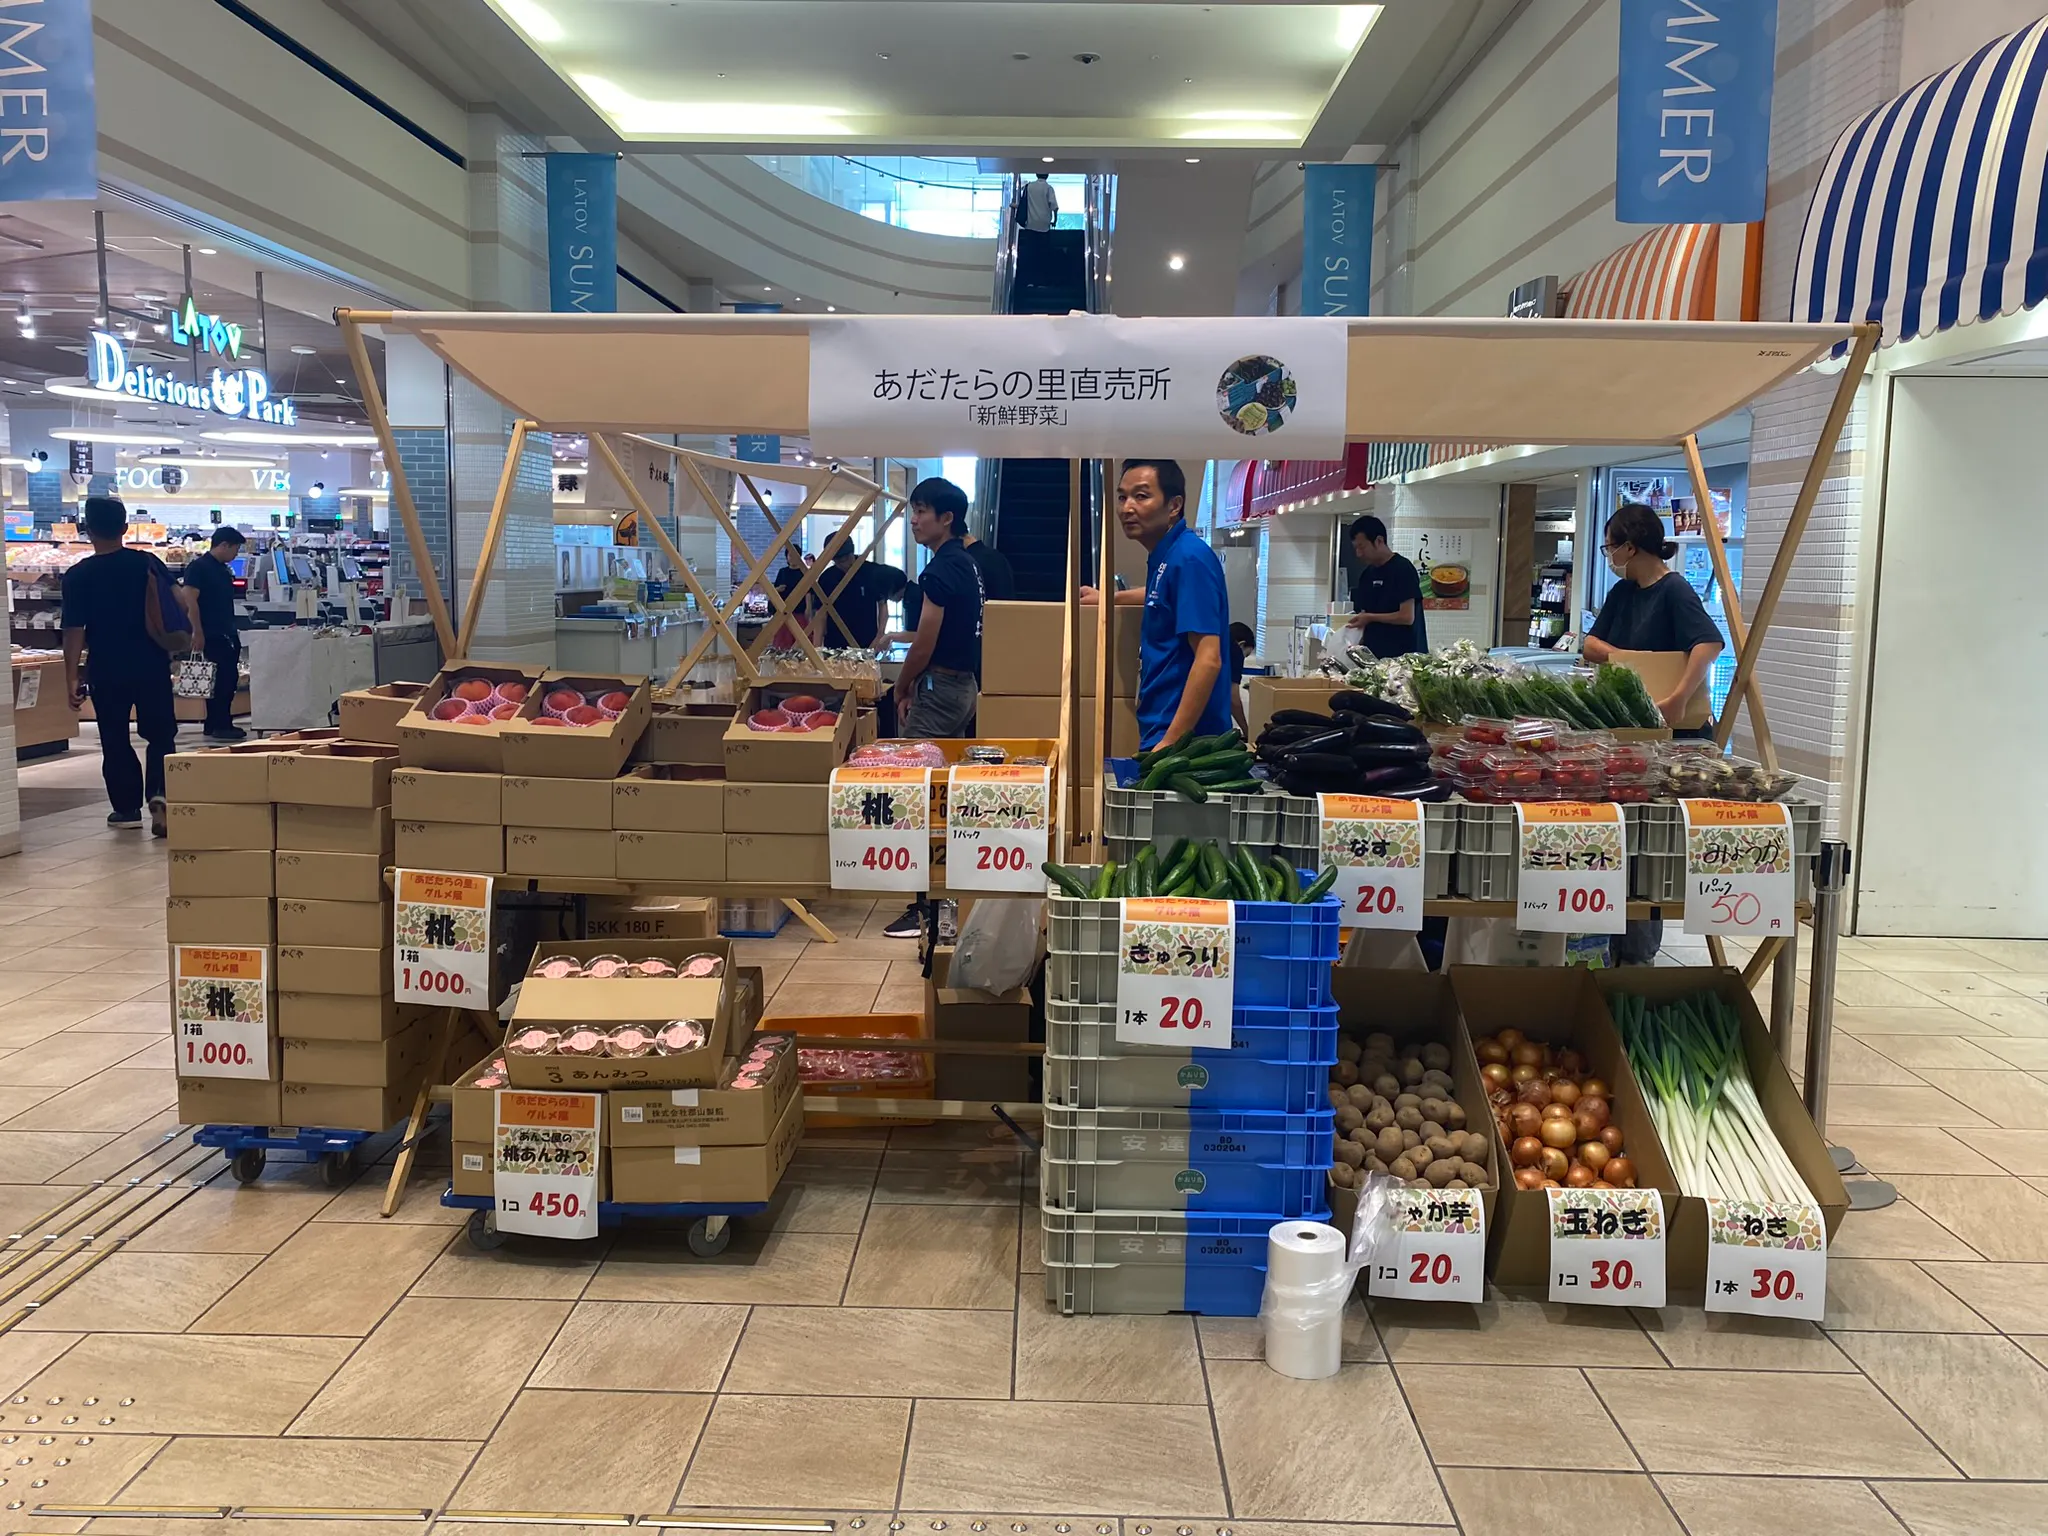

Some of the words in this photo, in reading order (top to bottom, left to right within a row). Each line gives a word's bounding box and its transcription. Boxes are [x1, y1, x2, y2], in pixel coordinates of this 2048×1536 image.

[574, 179, 588, 234] LATOV
[1331, 189, 1346, 245] LATOV
[171, 298, 242, 361] LATOV
[91, 331, 211, 411] Delicious
[244, 369, 296, 427] Park
[873, 367, 1172, 401] あだたらの里直売所
[967, 404, 1068, 427] 「新鮮野菜」
[392, 775, 416, 785] かぐや
[615, 785, 641, 796] かぐや
[862, 792, 895, 826] 桃
[956, 805, 1037, 819] ブルーベリー
[512, 834, 537, 845] かぐや
[618, 832, 644, 843] かぐや
[953, 830, 981, 839] 1パック
[835, 859, 857, 868] 1パック
[862, 846, 918, 871] 400円
[976, 846, 1033, 871] 200円
[1350, 838, 1390, 858] なす
[1529, 851, 1613, 868] ミニトマト
[1702, 834, 1785, 865] みょうが
[409, 874, 479, 890] 「あだたらの里」
[424, 888, 463, 901] グルメ展
[1699, 878, 1733, 896] 1パック
[1356, 885, 1404, 914] 20円
[1523, 901, 1548, 910] 1パック
[1558, 888, 1614, 913] 100円
[1711, 892, 1761, 926] 50
[1770, 919, 1780, 929] 円
[425, 912, 457, 946] 桃
[588, 920, 620, 934] SKK
[624, 920, 651, 933] 180
[655, 920, 665, 933] F
[400, 949, 420, 963] 1箱
[1129, 943, 1219, 968] きゅうり
[203, 963, 239, 974] グルメ展
[403, 968, 472, 995] 1,000円
[206, 986, 236, 1018] 桃
[1124, 1009, 1148, 1026] 1本
[1159, 996, 1212, 1029] 20円
[184, 1023, 203, 1036] 1箱
[186, 1041, 254, 1065] 1,000円
[572, 1069, 649, 1079] あんみつ
[526, 1110, 570, 1121] グルメ展
[502, 1145, 588, 1164] 桃あんみつ
[1203, 1144, 1247, 1153] 0302041
[501, 1199, 520, 1213] 1コ
[528, 1191, 587, 1218] 450円
[1406, 1200, 1473, 1225] ゃが芋
[1563, 1207, 1648, 1236] 玉ねぎ
[1743, 1214, 1788, 1239] ねぎ
[1200, 1246, 1243, 1255] 0302041
[1378, 1265, 1399, 1280] 1コ
[1408, 1252, 1461, 1285] 20円
[1557, 1272, 1579, 1287] 1コ
[1590, 1259, 1643, 1291] 30円
[1714, 1279, 1739, 1296] 1本
[1750, 1268, 1804, 1301] 30円
